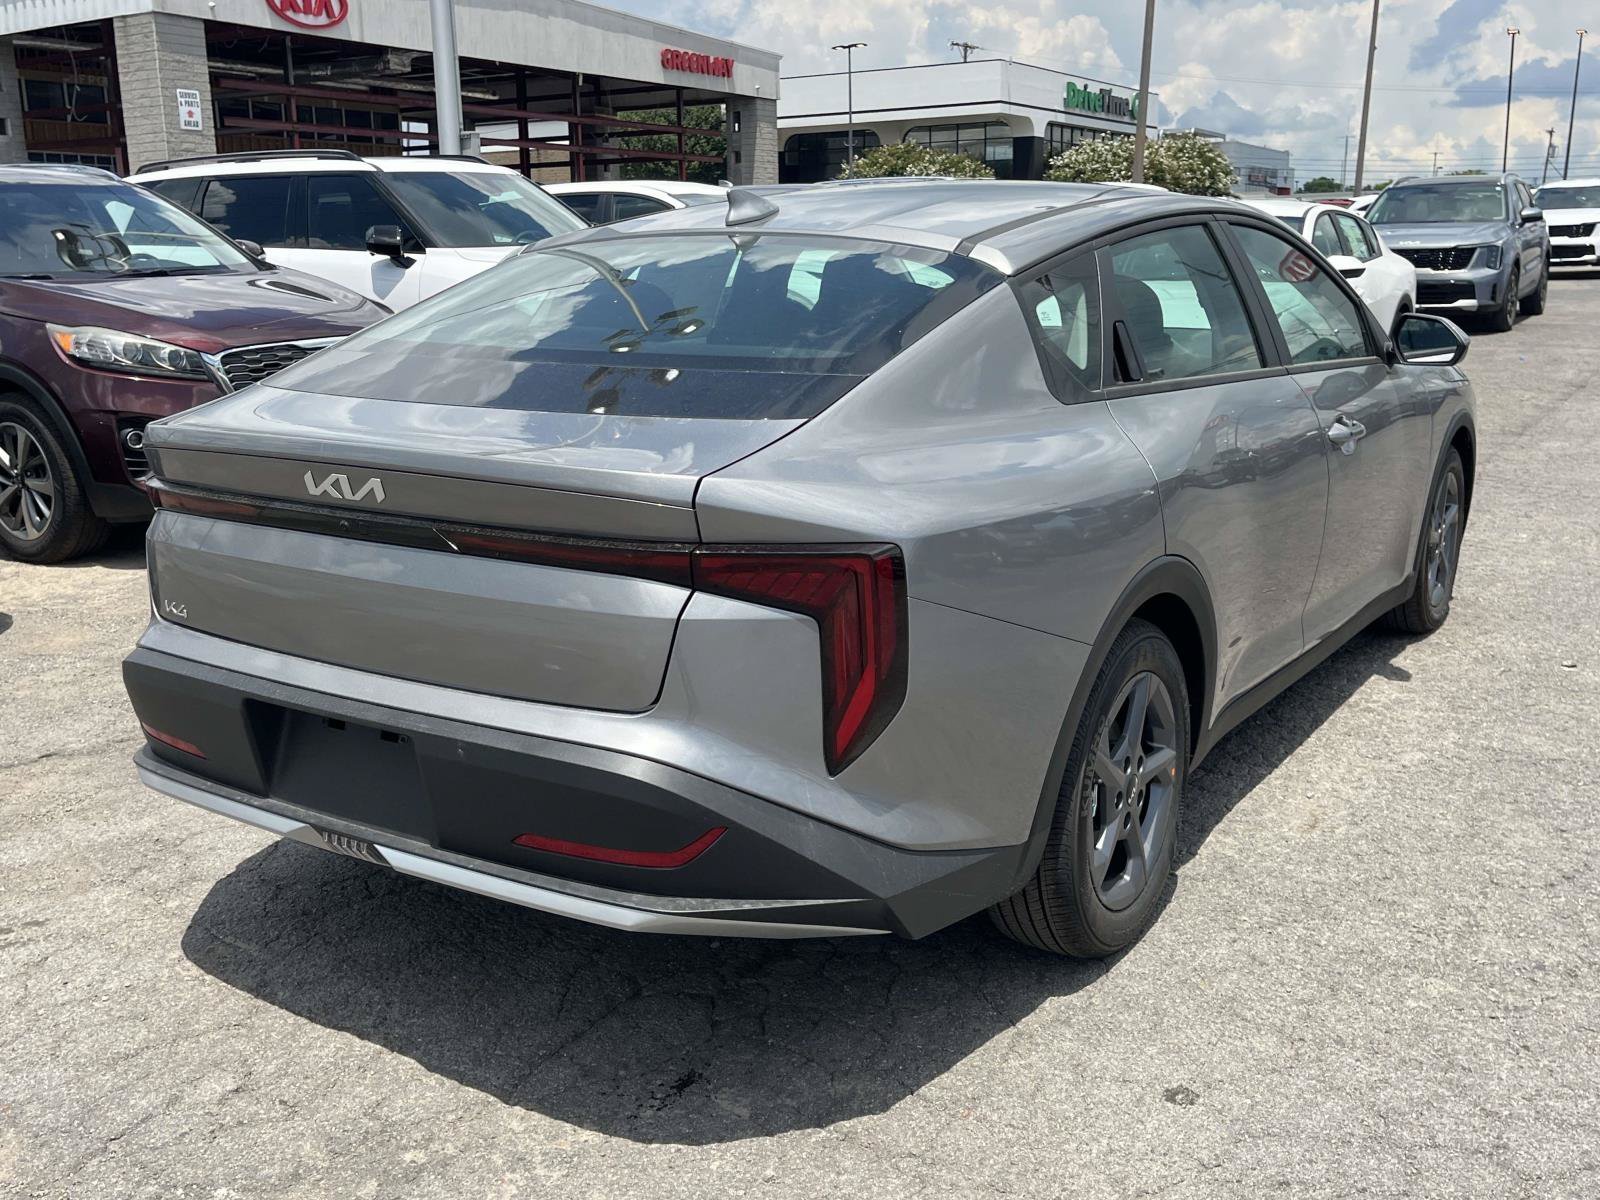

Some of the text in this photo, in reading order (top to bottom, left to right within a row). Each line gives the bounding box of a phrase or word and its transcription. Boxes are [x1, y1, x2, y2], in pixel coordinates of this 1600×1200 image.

[661, 48, 735, 78] GREENWAY
[1064, 82, 1130, 116] DriveTime
[303, 470, 386, 503] KIA
[164, 599, 187, 618] K4
